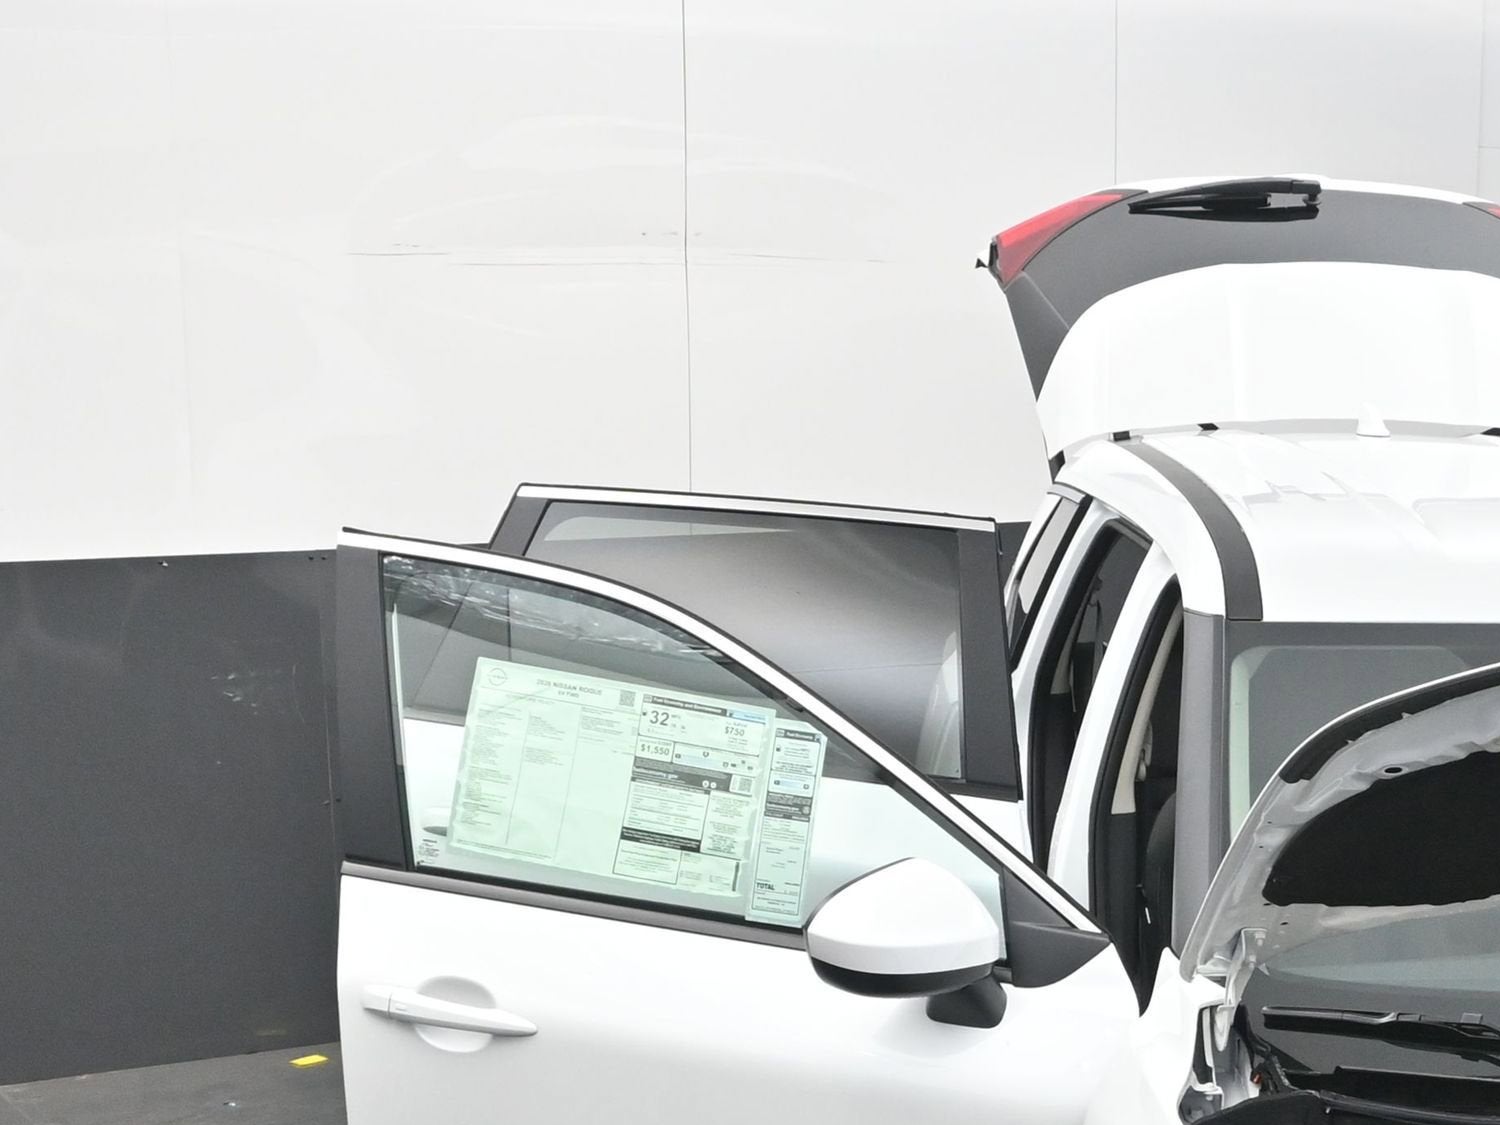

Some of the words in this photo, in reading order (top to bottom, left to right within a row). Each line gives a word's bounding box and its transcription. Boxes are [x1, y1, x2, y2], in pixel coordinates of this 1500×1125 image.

[553, 681, 578, 691] NISSAN
[649, 710, 670, 726] 32
[725, 725, 745, 737] $750
[640, 743, 670, 756] $1,550
[756, 882, 775, 891] TOTAL
